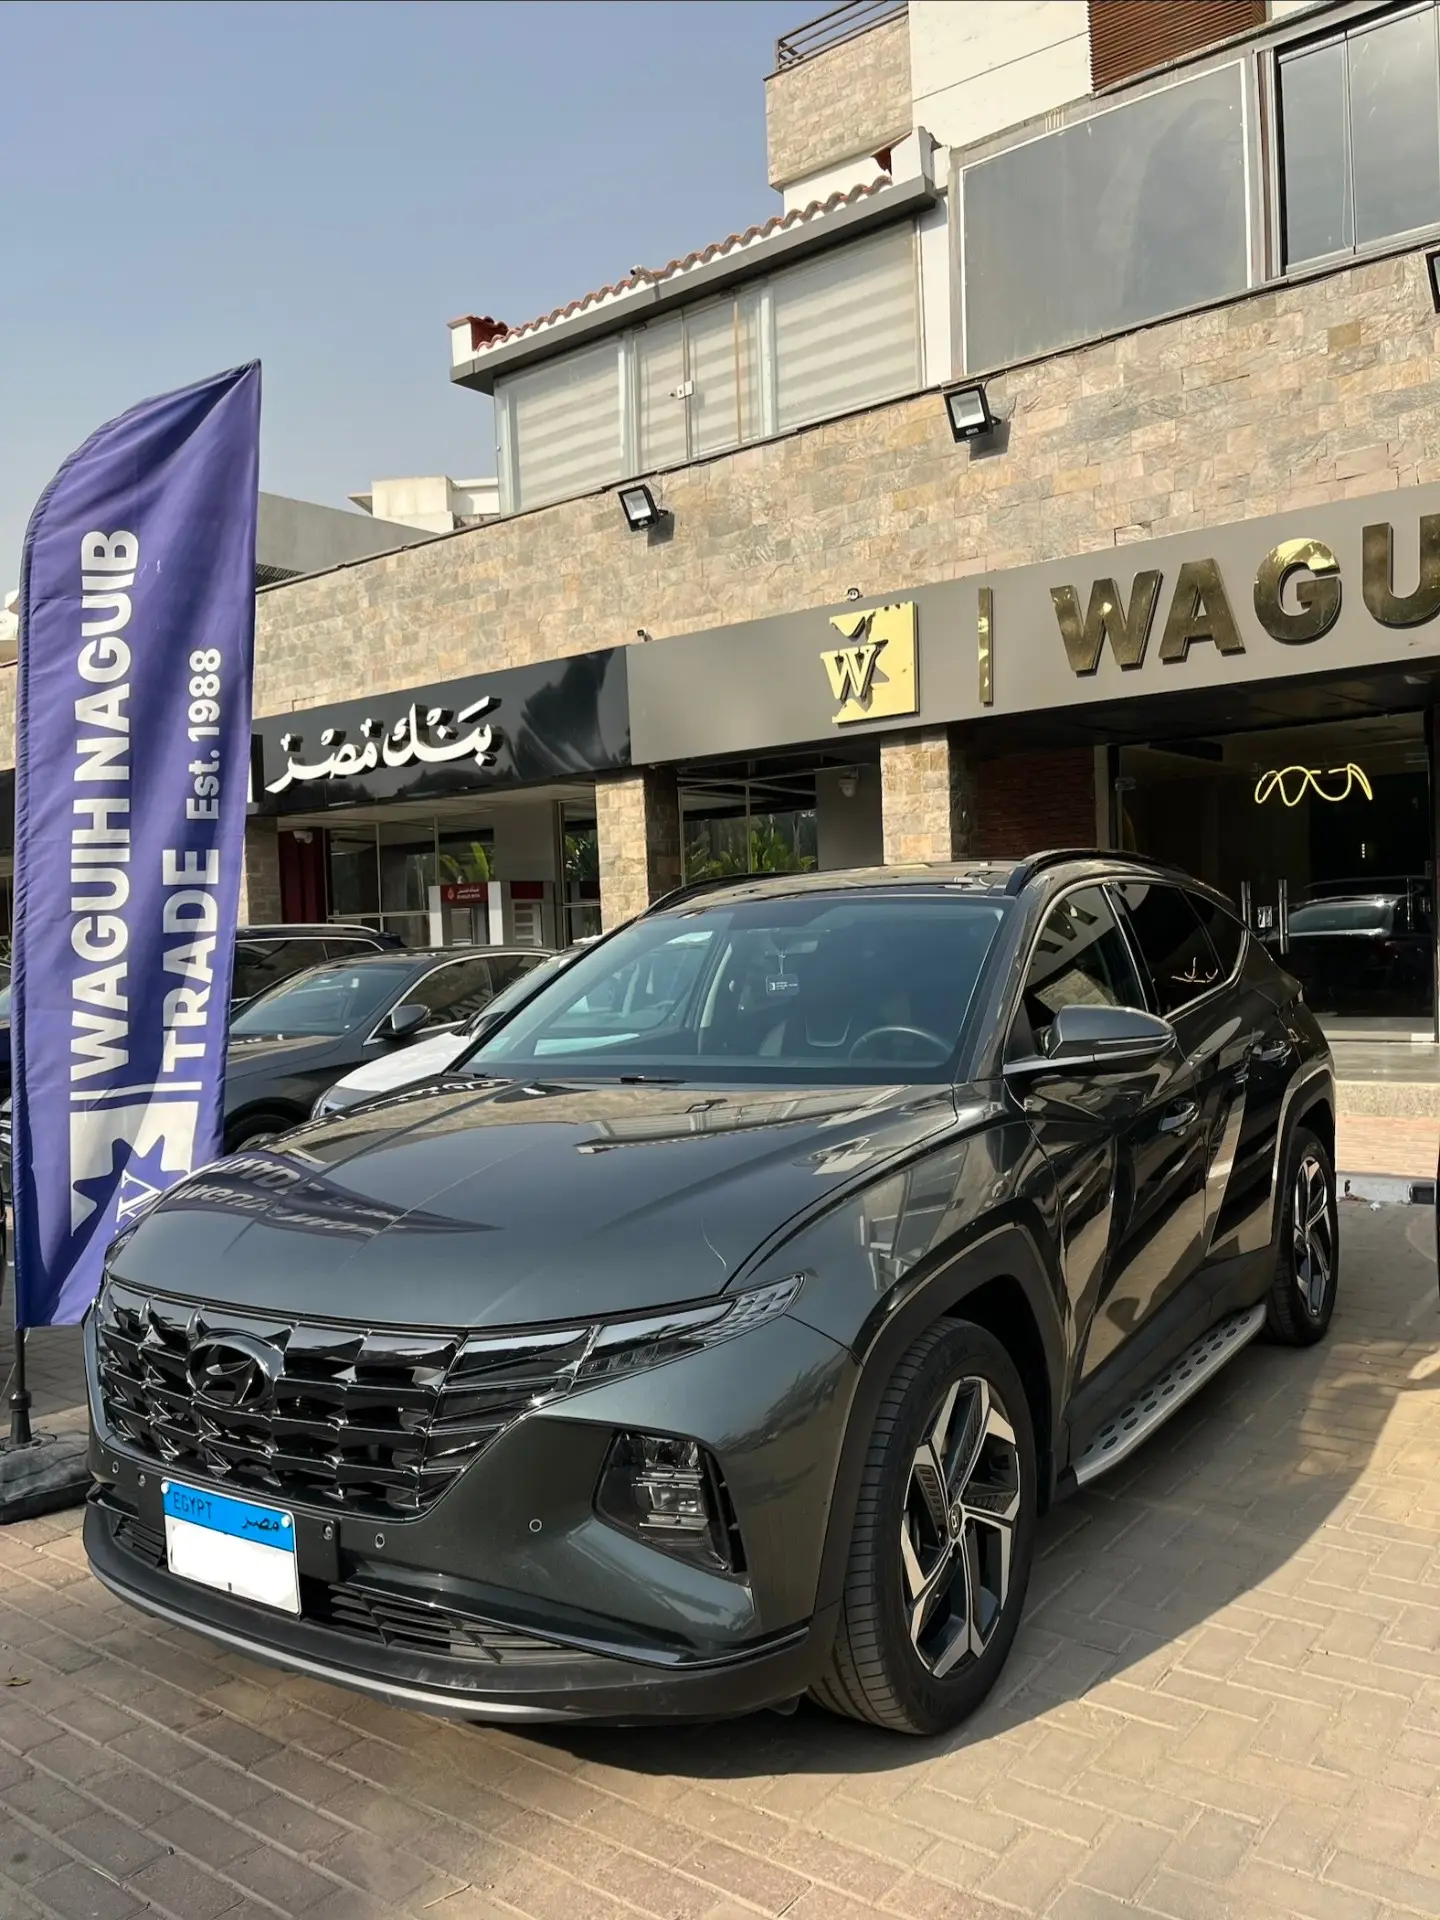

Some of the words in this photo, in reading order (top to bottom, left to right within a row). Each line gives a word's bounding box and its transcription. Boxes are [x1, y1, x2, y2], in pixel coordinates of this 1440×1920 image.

[74, 530, 139, 782] NAGUIB
[188, 648, 221, 743] 1988
[186, 749, 220, 820] Est.
[71, 798, 130, 1081] WAGUIH
[163, 848, 219, 1073] TRADE
[173, 1492, 212, 1520] EGYPT
[241, 1516, 280, 1532] مصر
